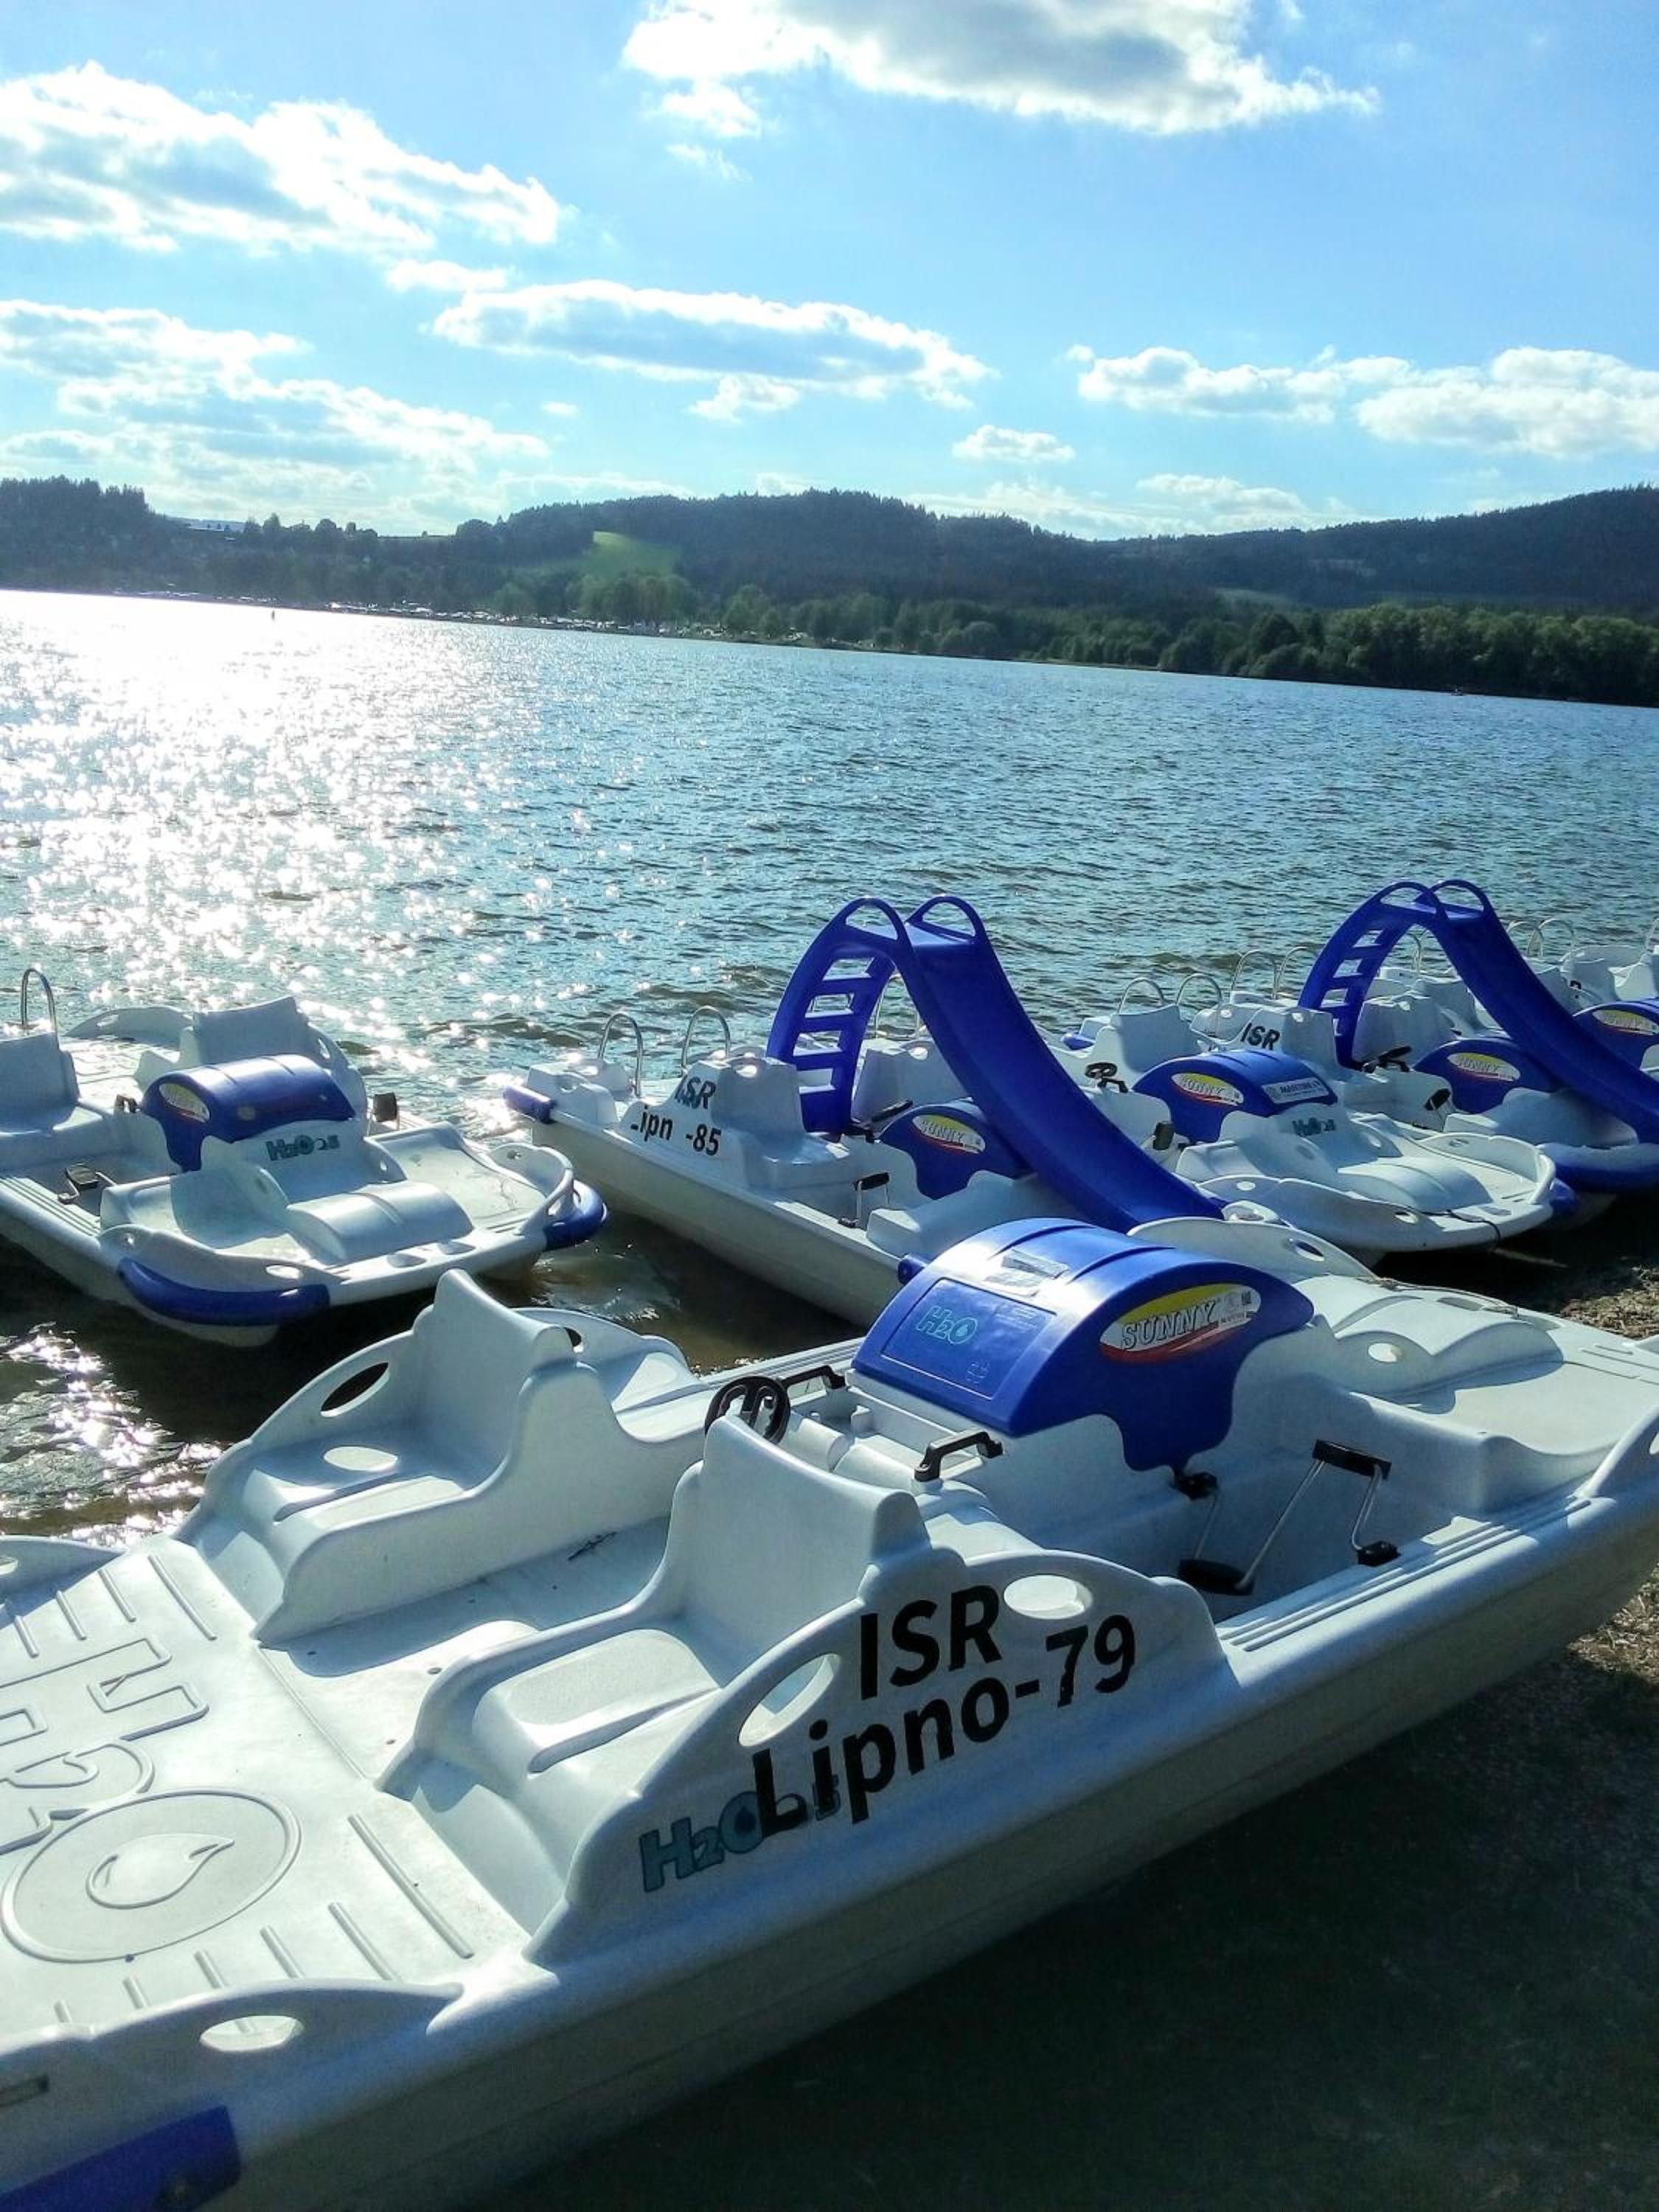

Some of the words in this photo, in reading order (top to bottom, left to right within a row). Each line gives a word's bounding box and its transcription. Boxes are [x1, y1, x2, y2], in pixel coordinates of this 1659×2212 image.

[1240, 1023, 1281, 1051] ISR
[675, 1075, 716, 1109] ISR
[915, 1305, 978, 1344] H2O
[1121, 1301, 1216, 1350] SUNNY
[860, 1585, 1002, 1700] ISR
[753, 1615, 1135, 1838] Lipno-79
